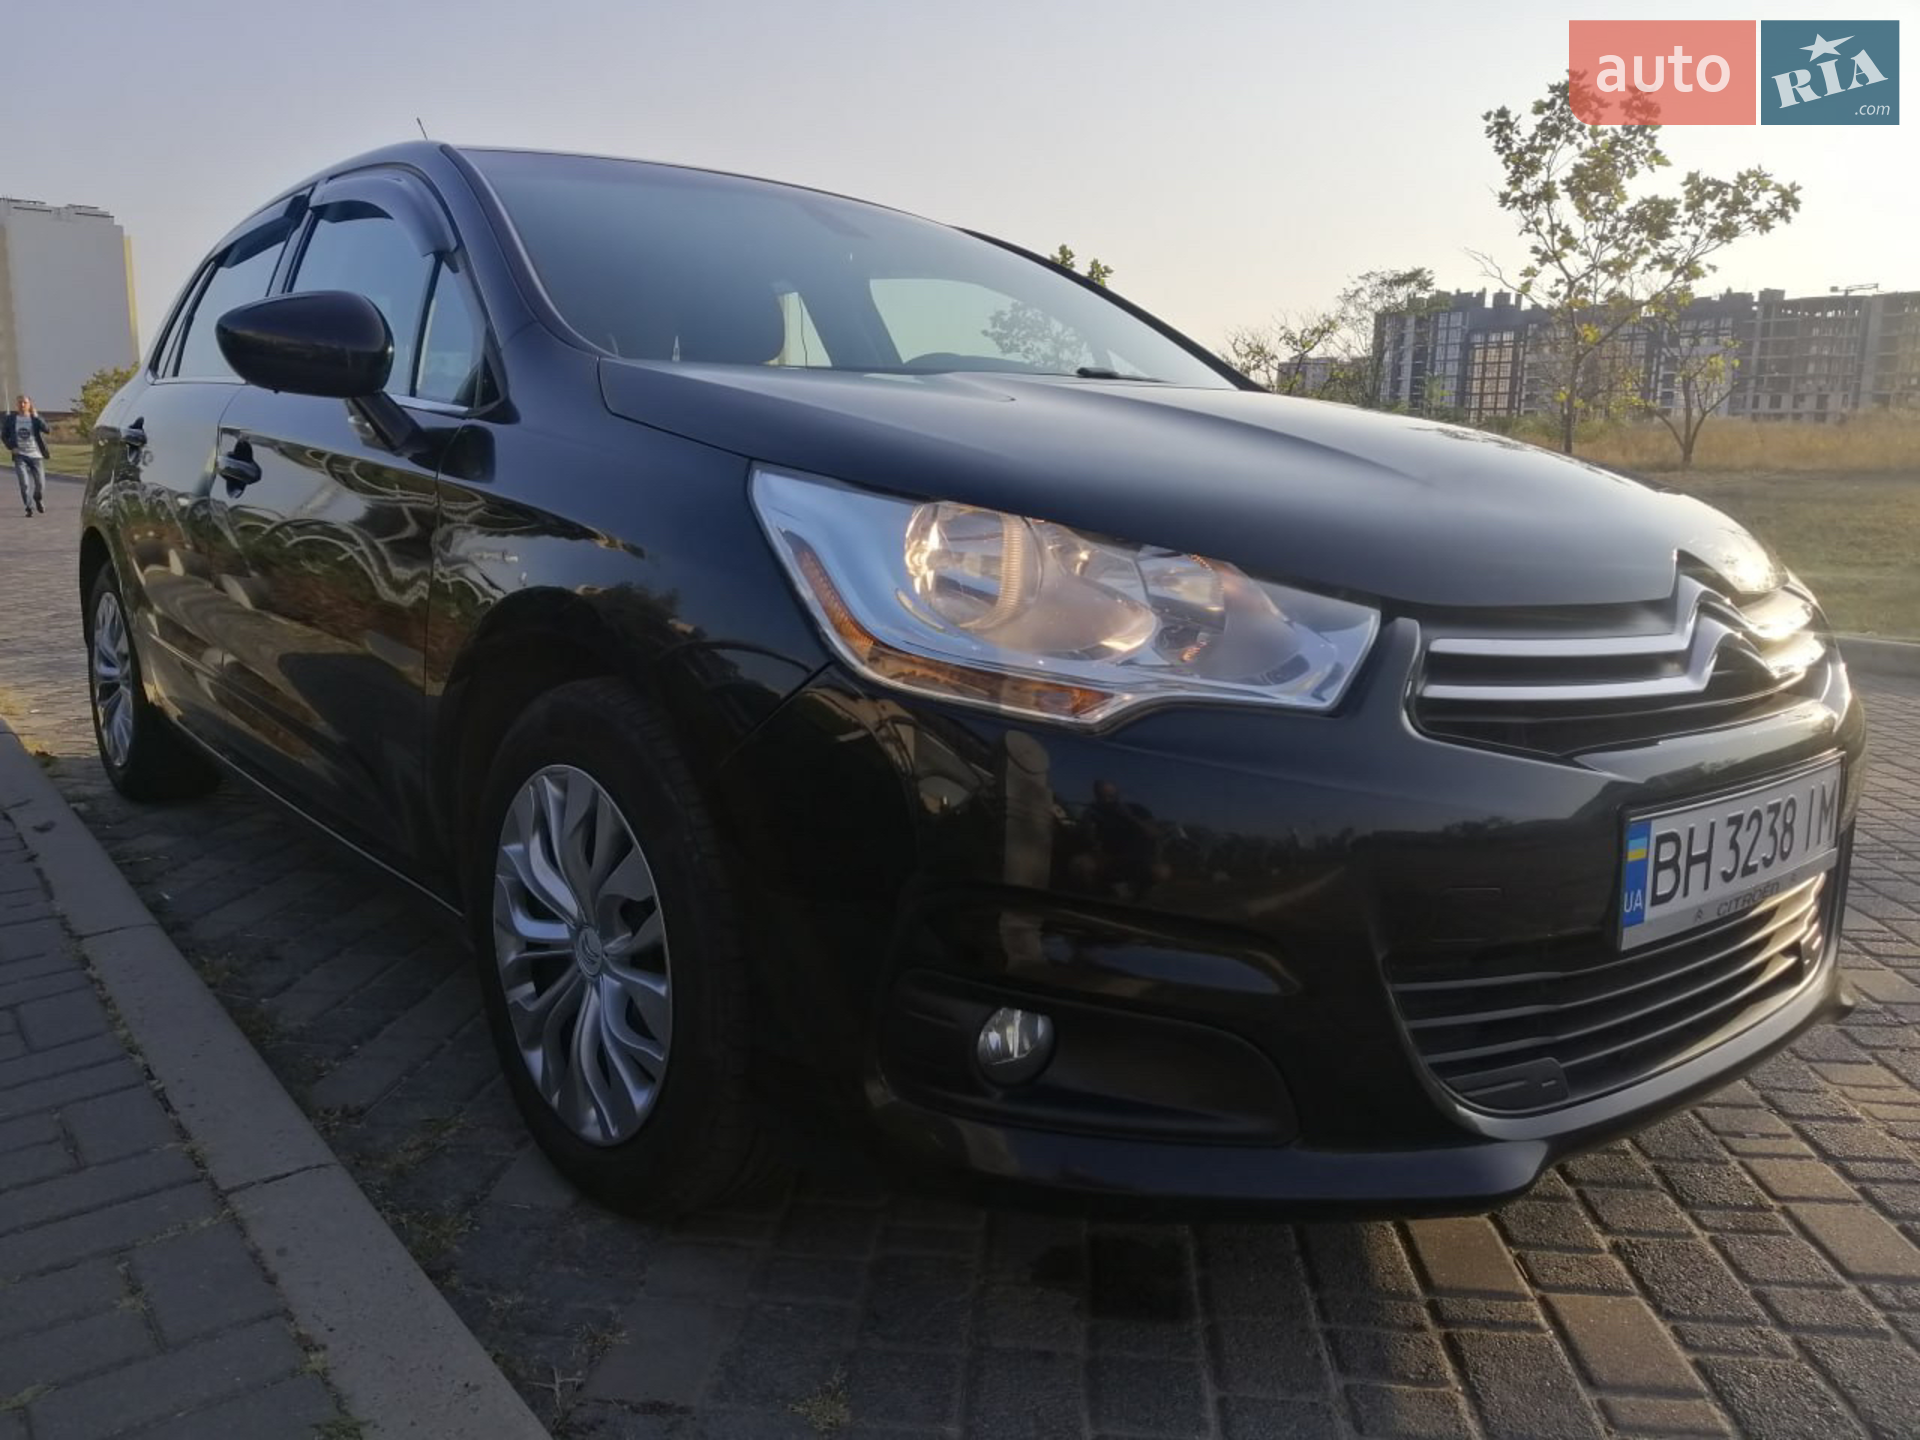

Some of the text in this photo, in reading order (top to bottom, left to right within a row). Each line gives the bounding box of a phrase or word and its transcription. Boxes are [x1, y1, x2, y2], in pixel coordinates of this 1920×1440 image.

[1650, 780, 1838, 907] BH 3238 IM
[1624, 890, 1643, 912] UA
